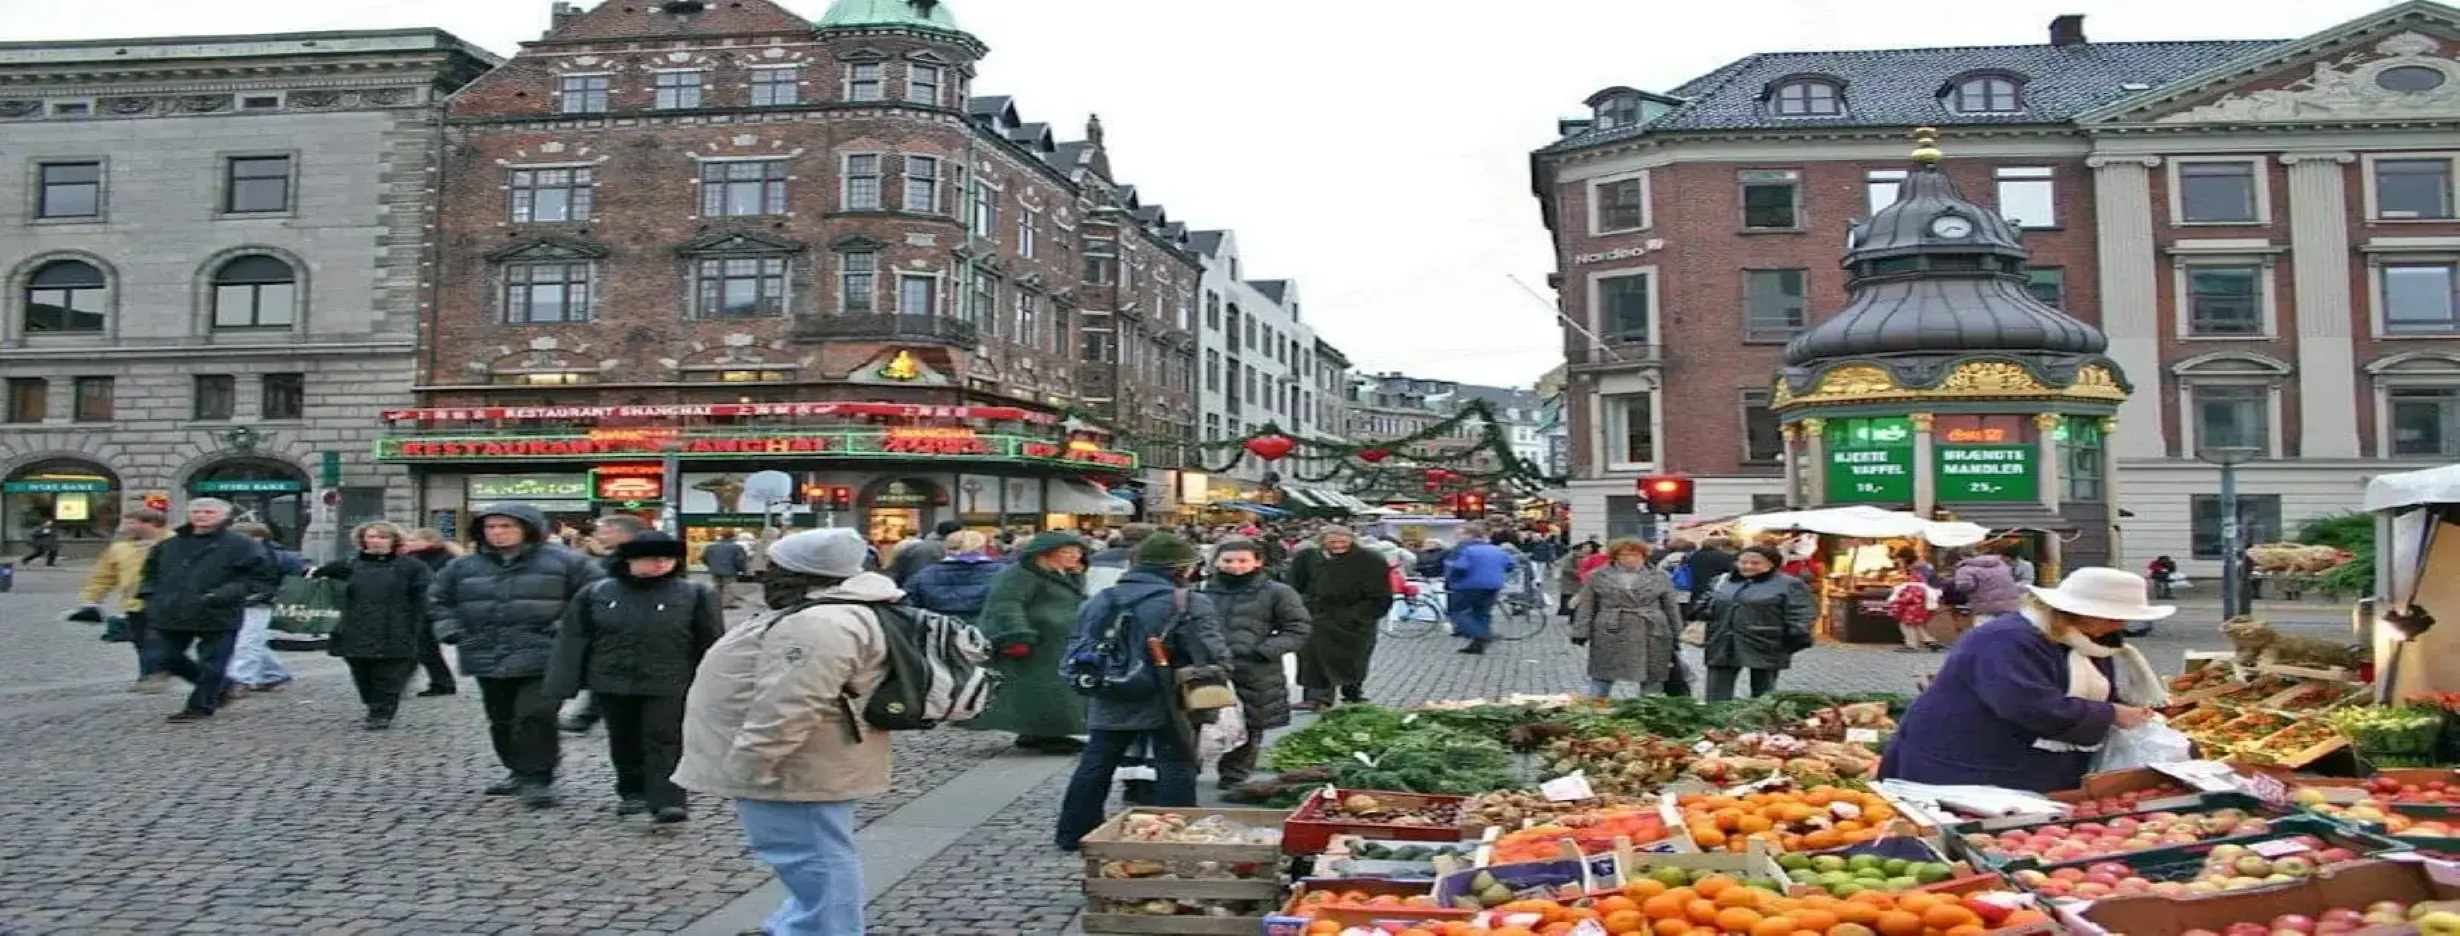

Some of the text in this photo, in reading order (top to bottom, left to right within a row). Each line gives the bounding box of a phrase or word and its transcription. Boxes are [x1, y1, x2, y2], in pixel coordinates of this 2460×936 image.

[504, 404, 711, 419] RESTAURANT SHANGHAI
[402, 438, 613, 455] RESTAURANT
[1943, 450, 2025, 461] BRÆNDTE
[1943, 463, 2024, 474] MANDLER
